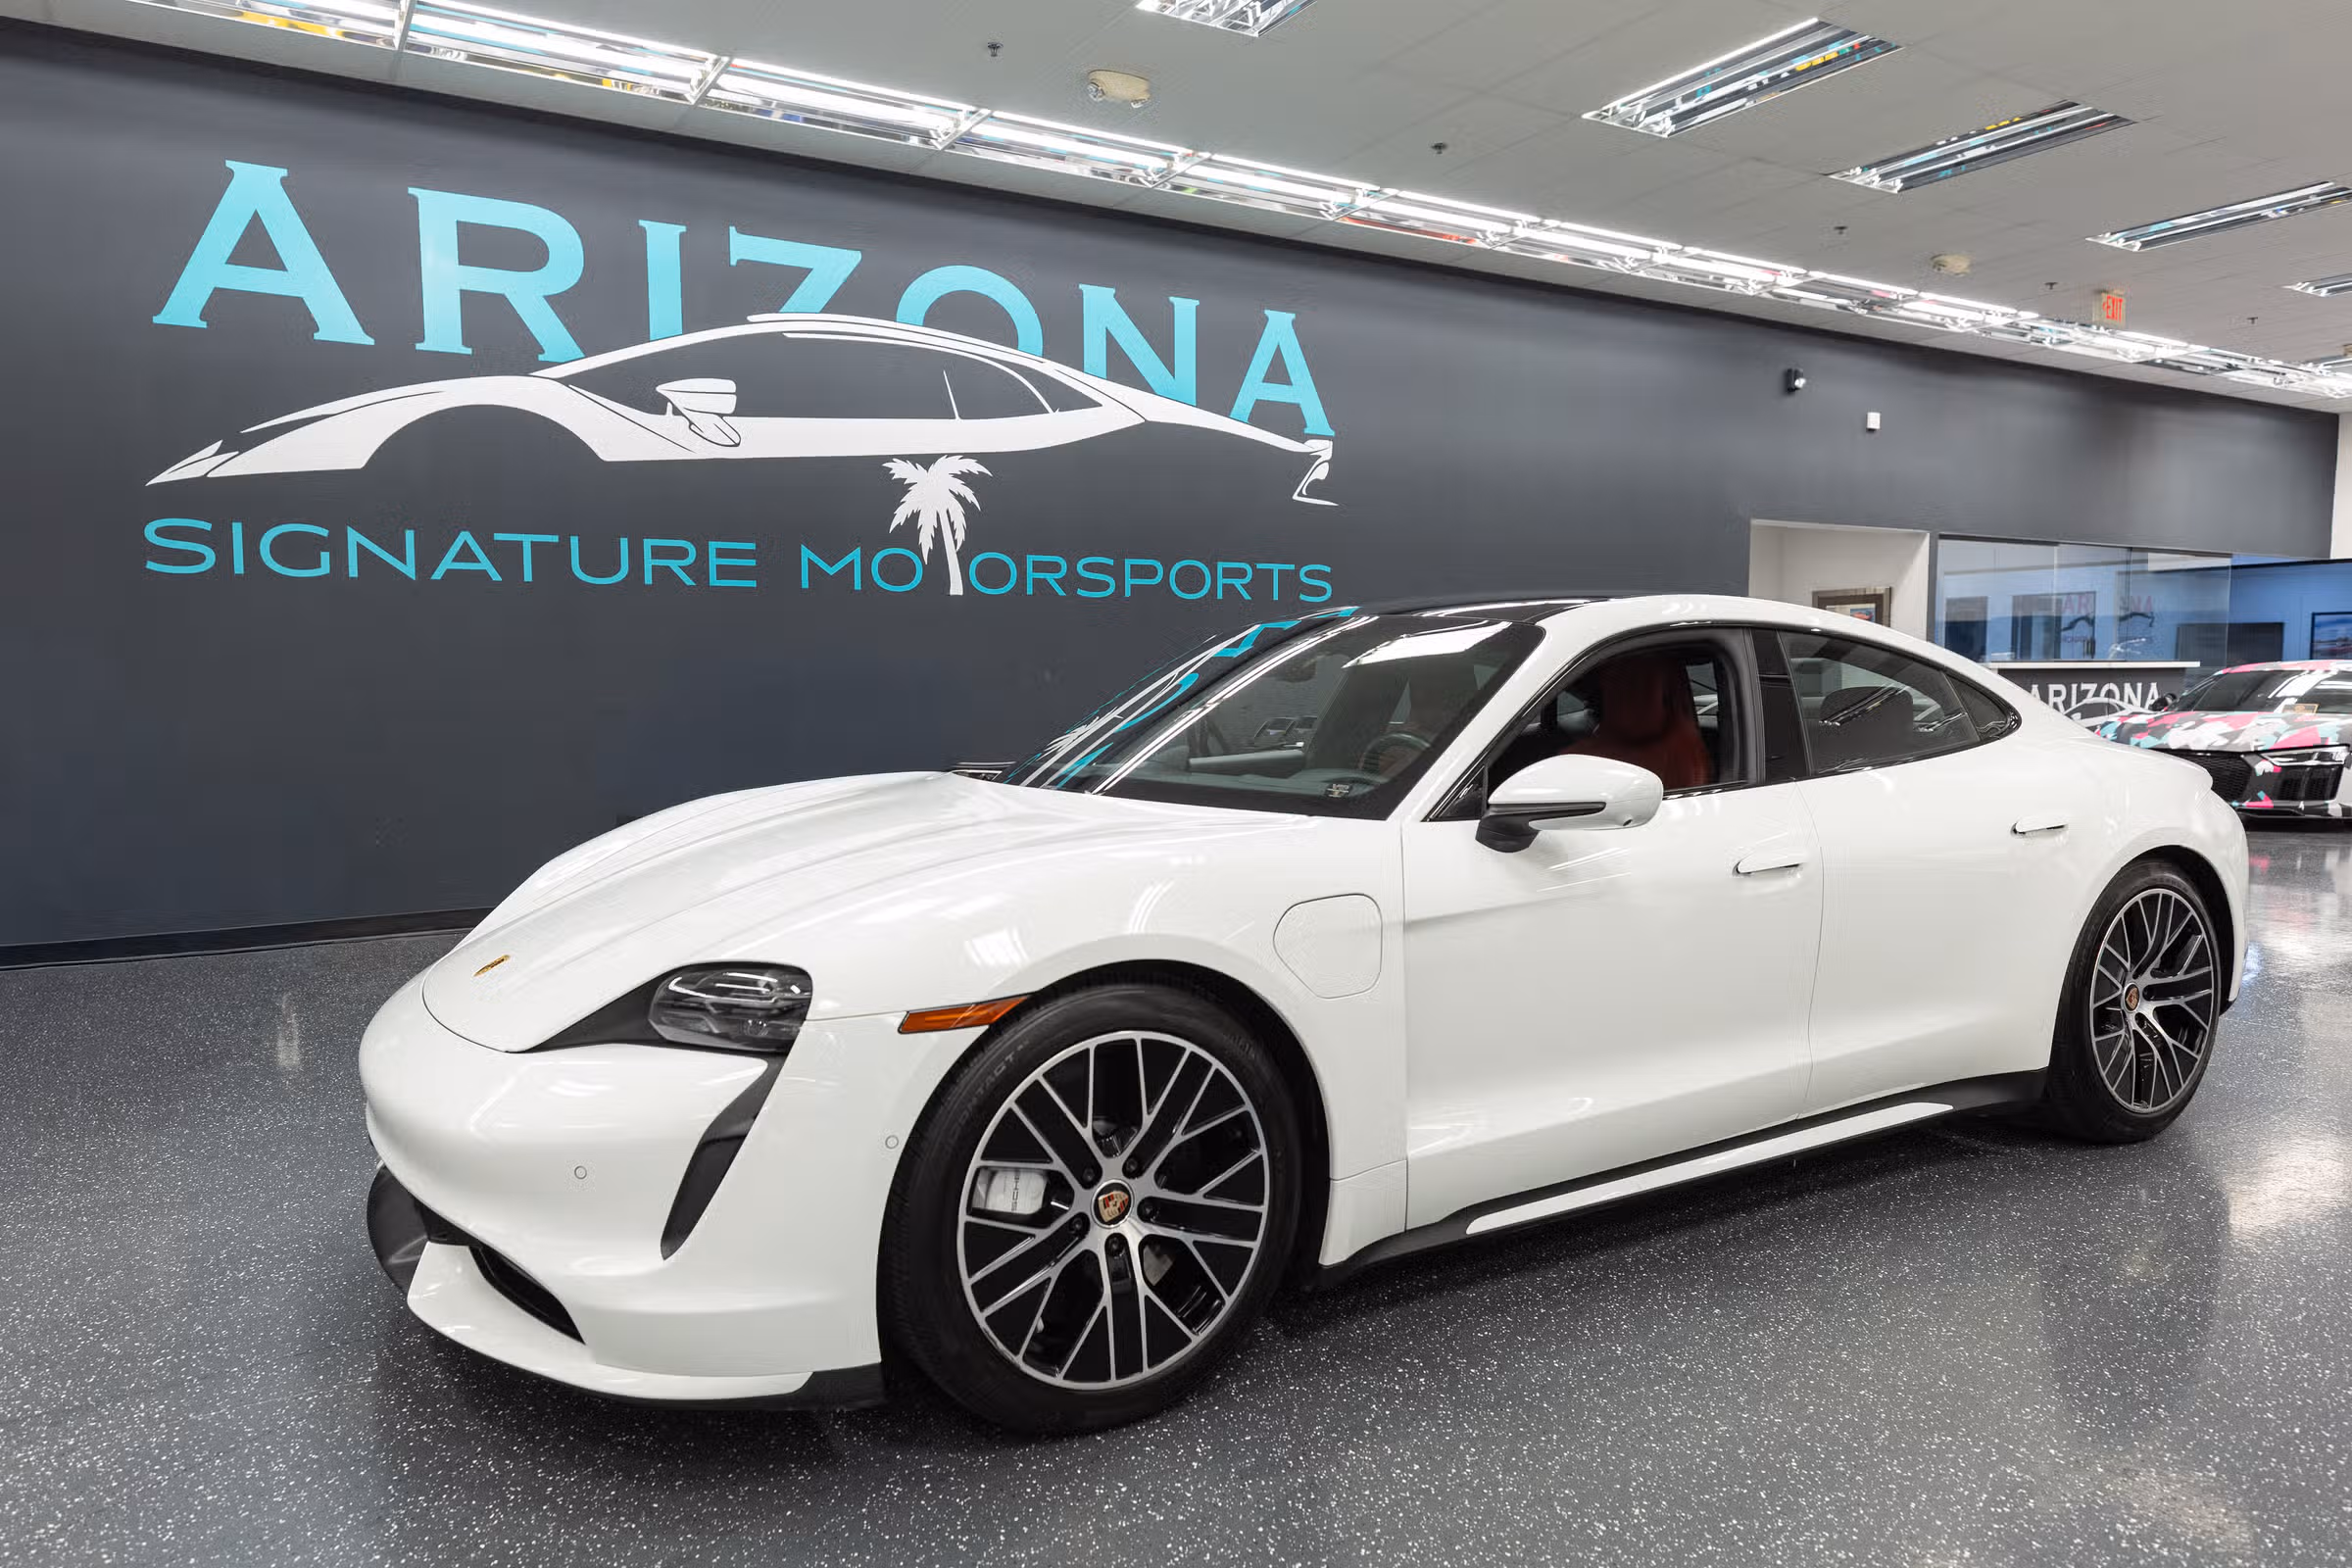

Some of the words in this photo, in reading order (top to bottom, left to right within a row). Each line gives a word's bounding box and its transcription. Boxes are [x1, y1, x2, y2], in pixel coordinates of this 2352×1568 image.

[153, 161, 1335, 437] ARIZONA
[2106, 295, 2124, 323] EXIT
[144, 518, 757, 588] SIGNATURE
[2031, 682, 2160, 714] ARIZONA
